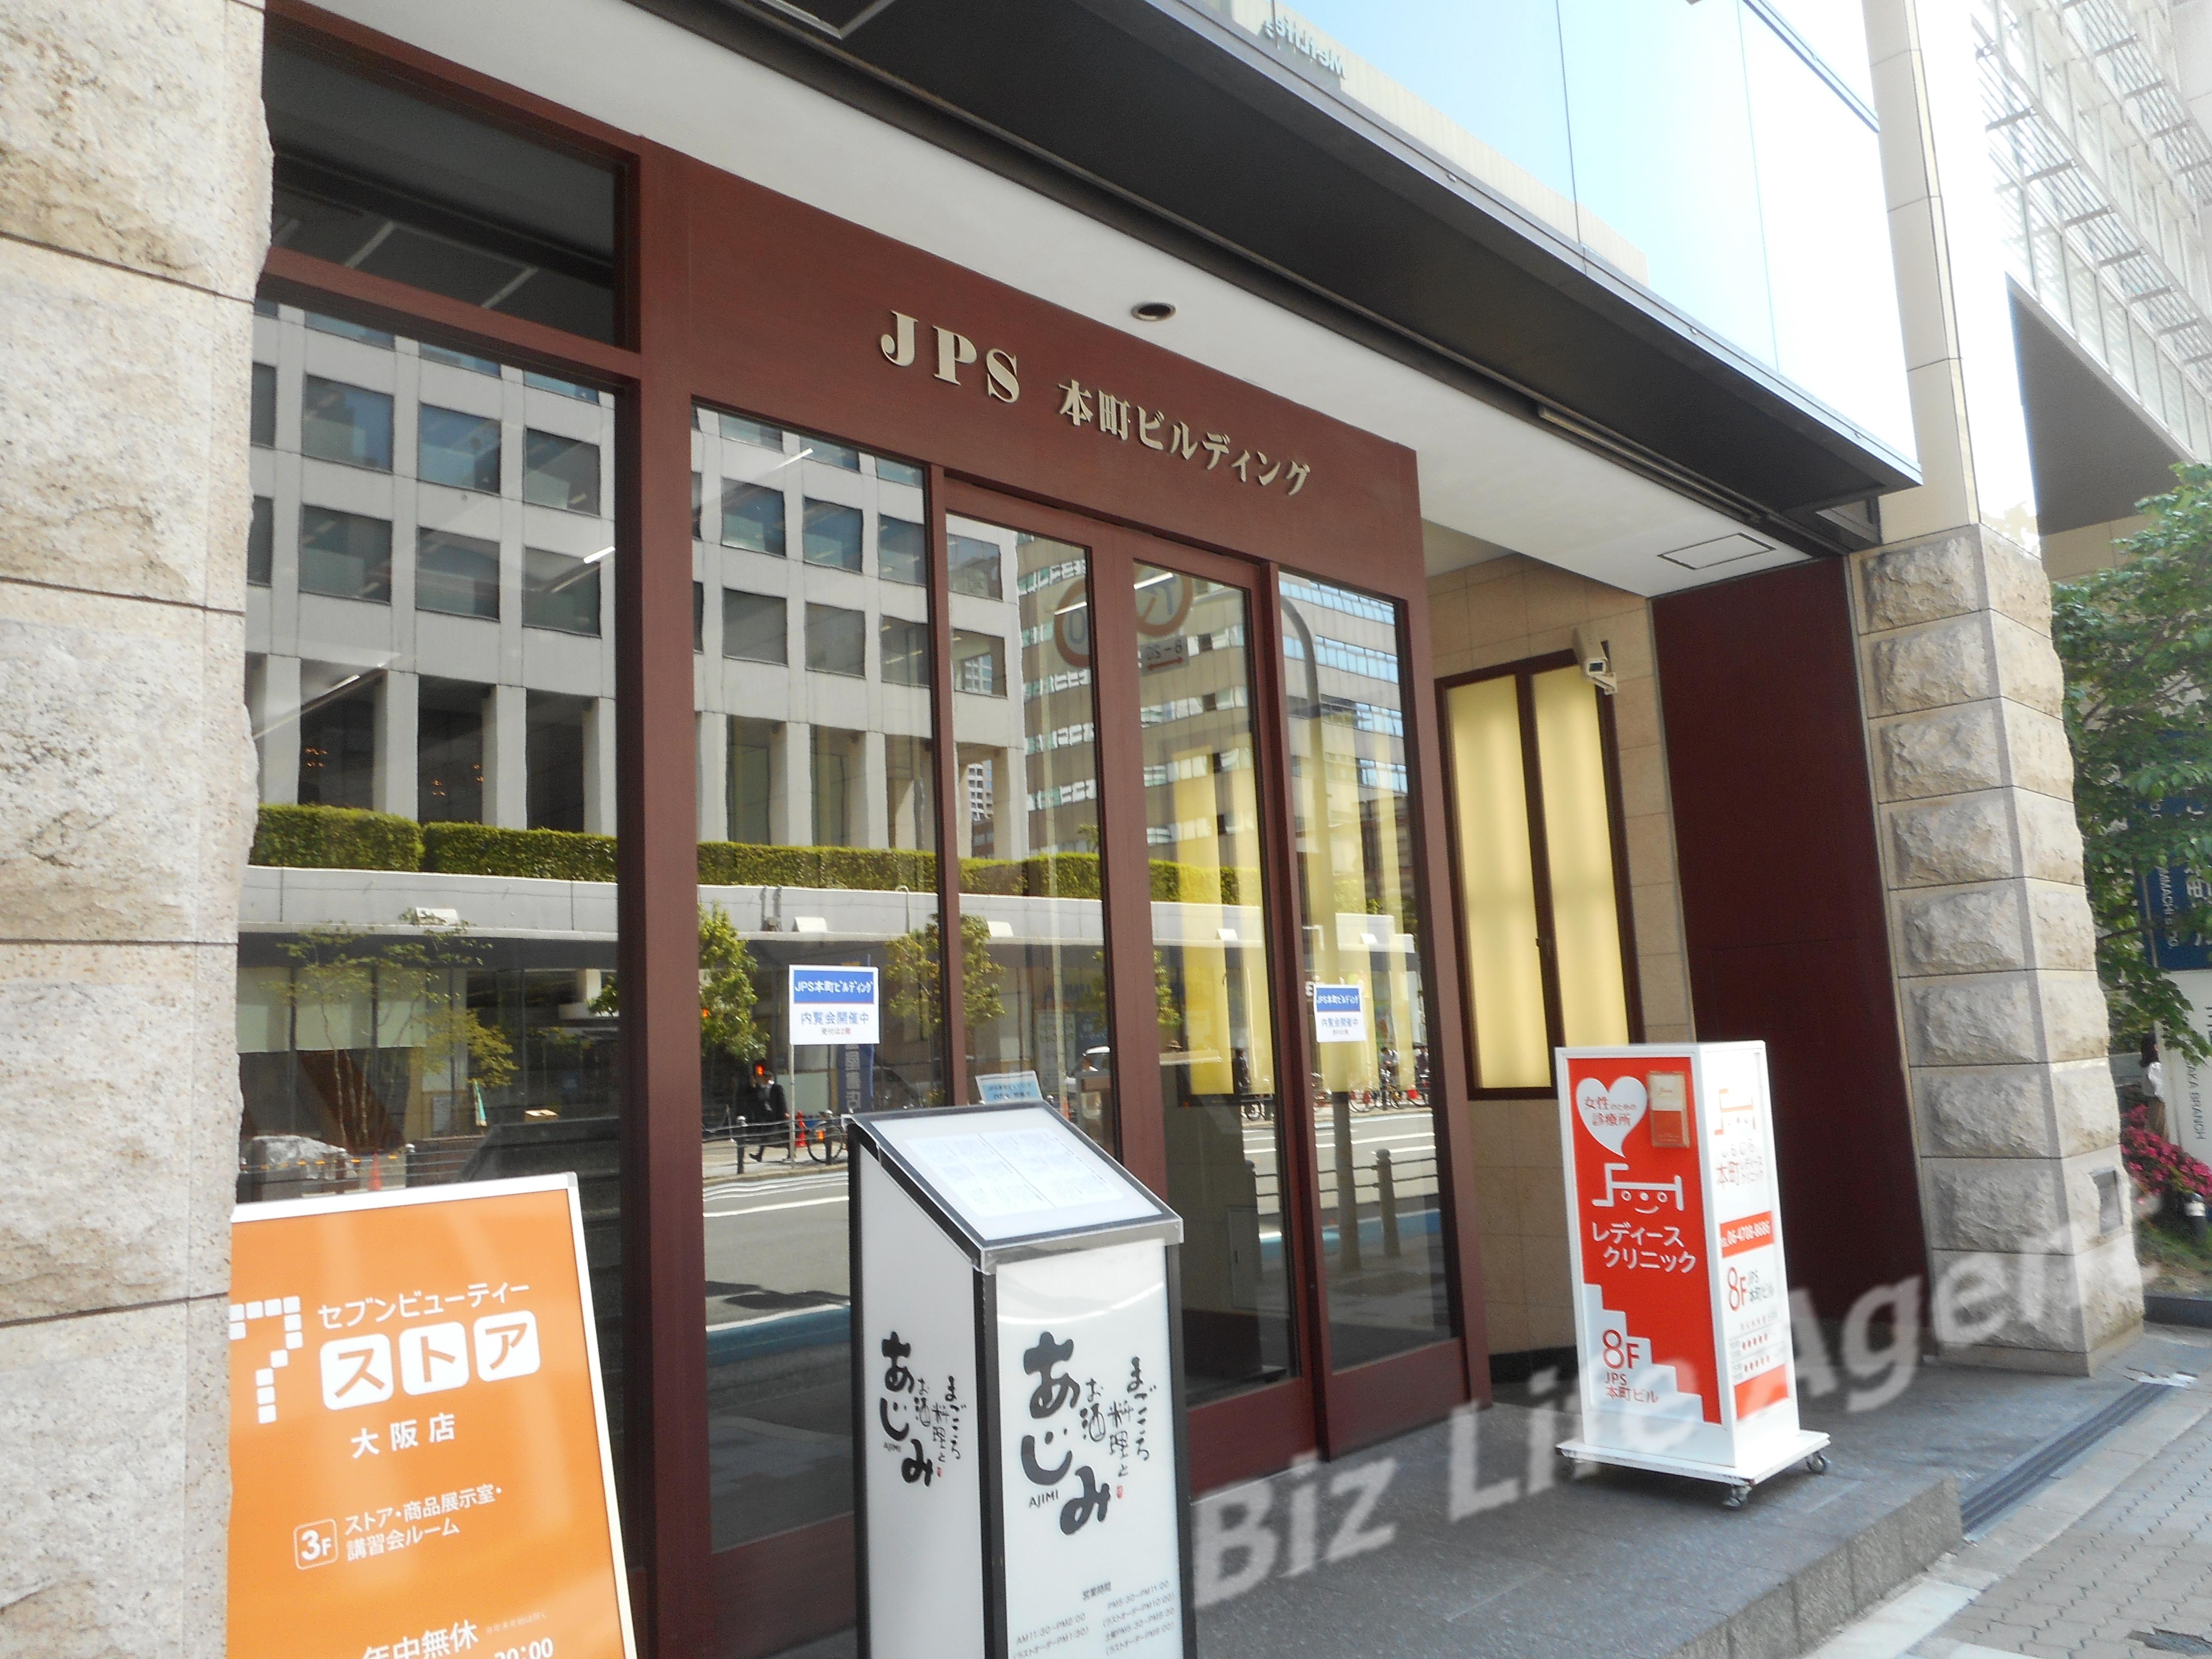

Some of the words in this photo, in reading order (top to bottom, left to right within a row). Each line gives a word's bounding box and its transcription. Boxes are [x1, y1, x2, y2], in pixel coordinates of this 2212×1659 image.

[880, 310, 1021, 403] JPS
[1058, 379, 1310, 495] 本町ビルディング
[801, 1011, 869, 1025] 内覧会開催中
[1592, 1221, 1684, 1248] レディース
[1603, 1246, 1696, 1273] クリニック
[318, 1282, 530, 1329] セブンビューティー
[1727, 1267, 1748, 1312] 8F
[333, 1322, 528, 1398] ストア
[1602, 1329, 1640, 1370] 8F
[1604, 1371, 1628, 1386] JPS
[1605, 1386, 1659, 1404] 本町ビル
[350, 1412, 456, 1459] 大阪店
[1021, 1331, 1111, 1535] あじみ
[1029, 1489, 1060, 1509] AJIMI
[301, 1529, 332, 1561] 3F
[346, 1516, 460, 1562] 講習会ルーム
